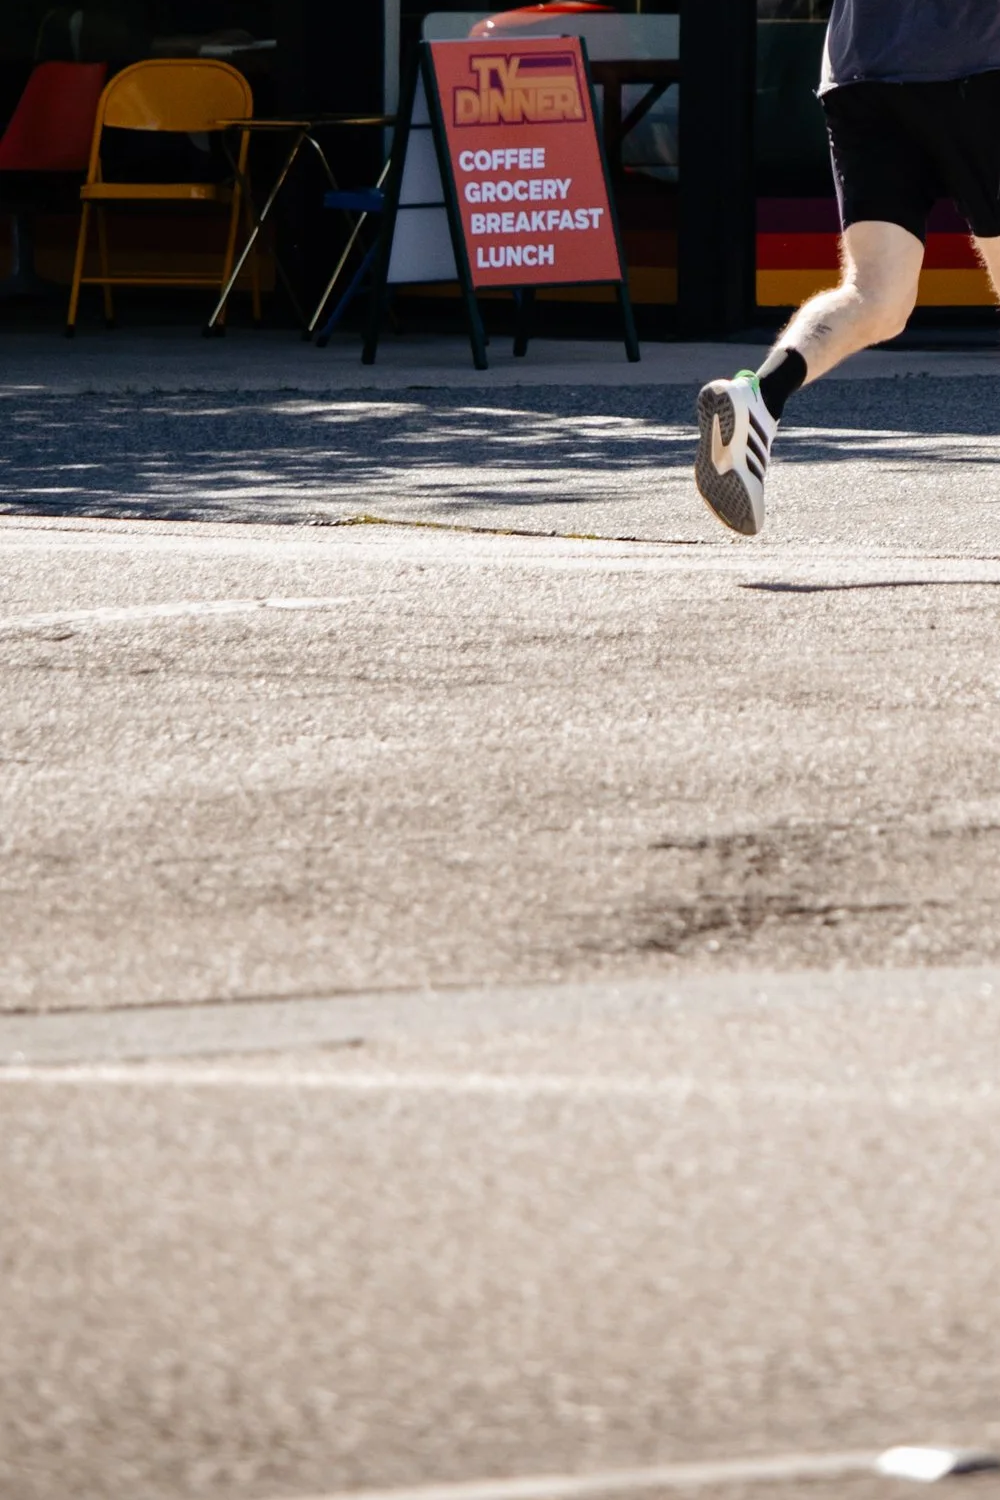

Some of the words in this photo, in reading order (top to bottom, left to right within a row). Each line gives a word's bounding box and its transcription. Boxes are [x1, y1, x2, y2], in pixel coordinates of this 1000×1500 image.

[471, 56, 521, 90] TV
[455, 88, 582, 126] DINNER
[459, 148, 546, 172] COFFEE
[464, 178, 572, 204] GROCERY
[471, 208, 604, 235] BREAKFAST
[477, 244, 554, 268] LUNCH
